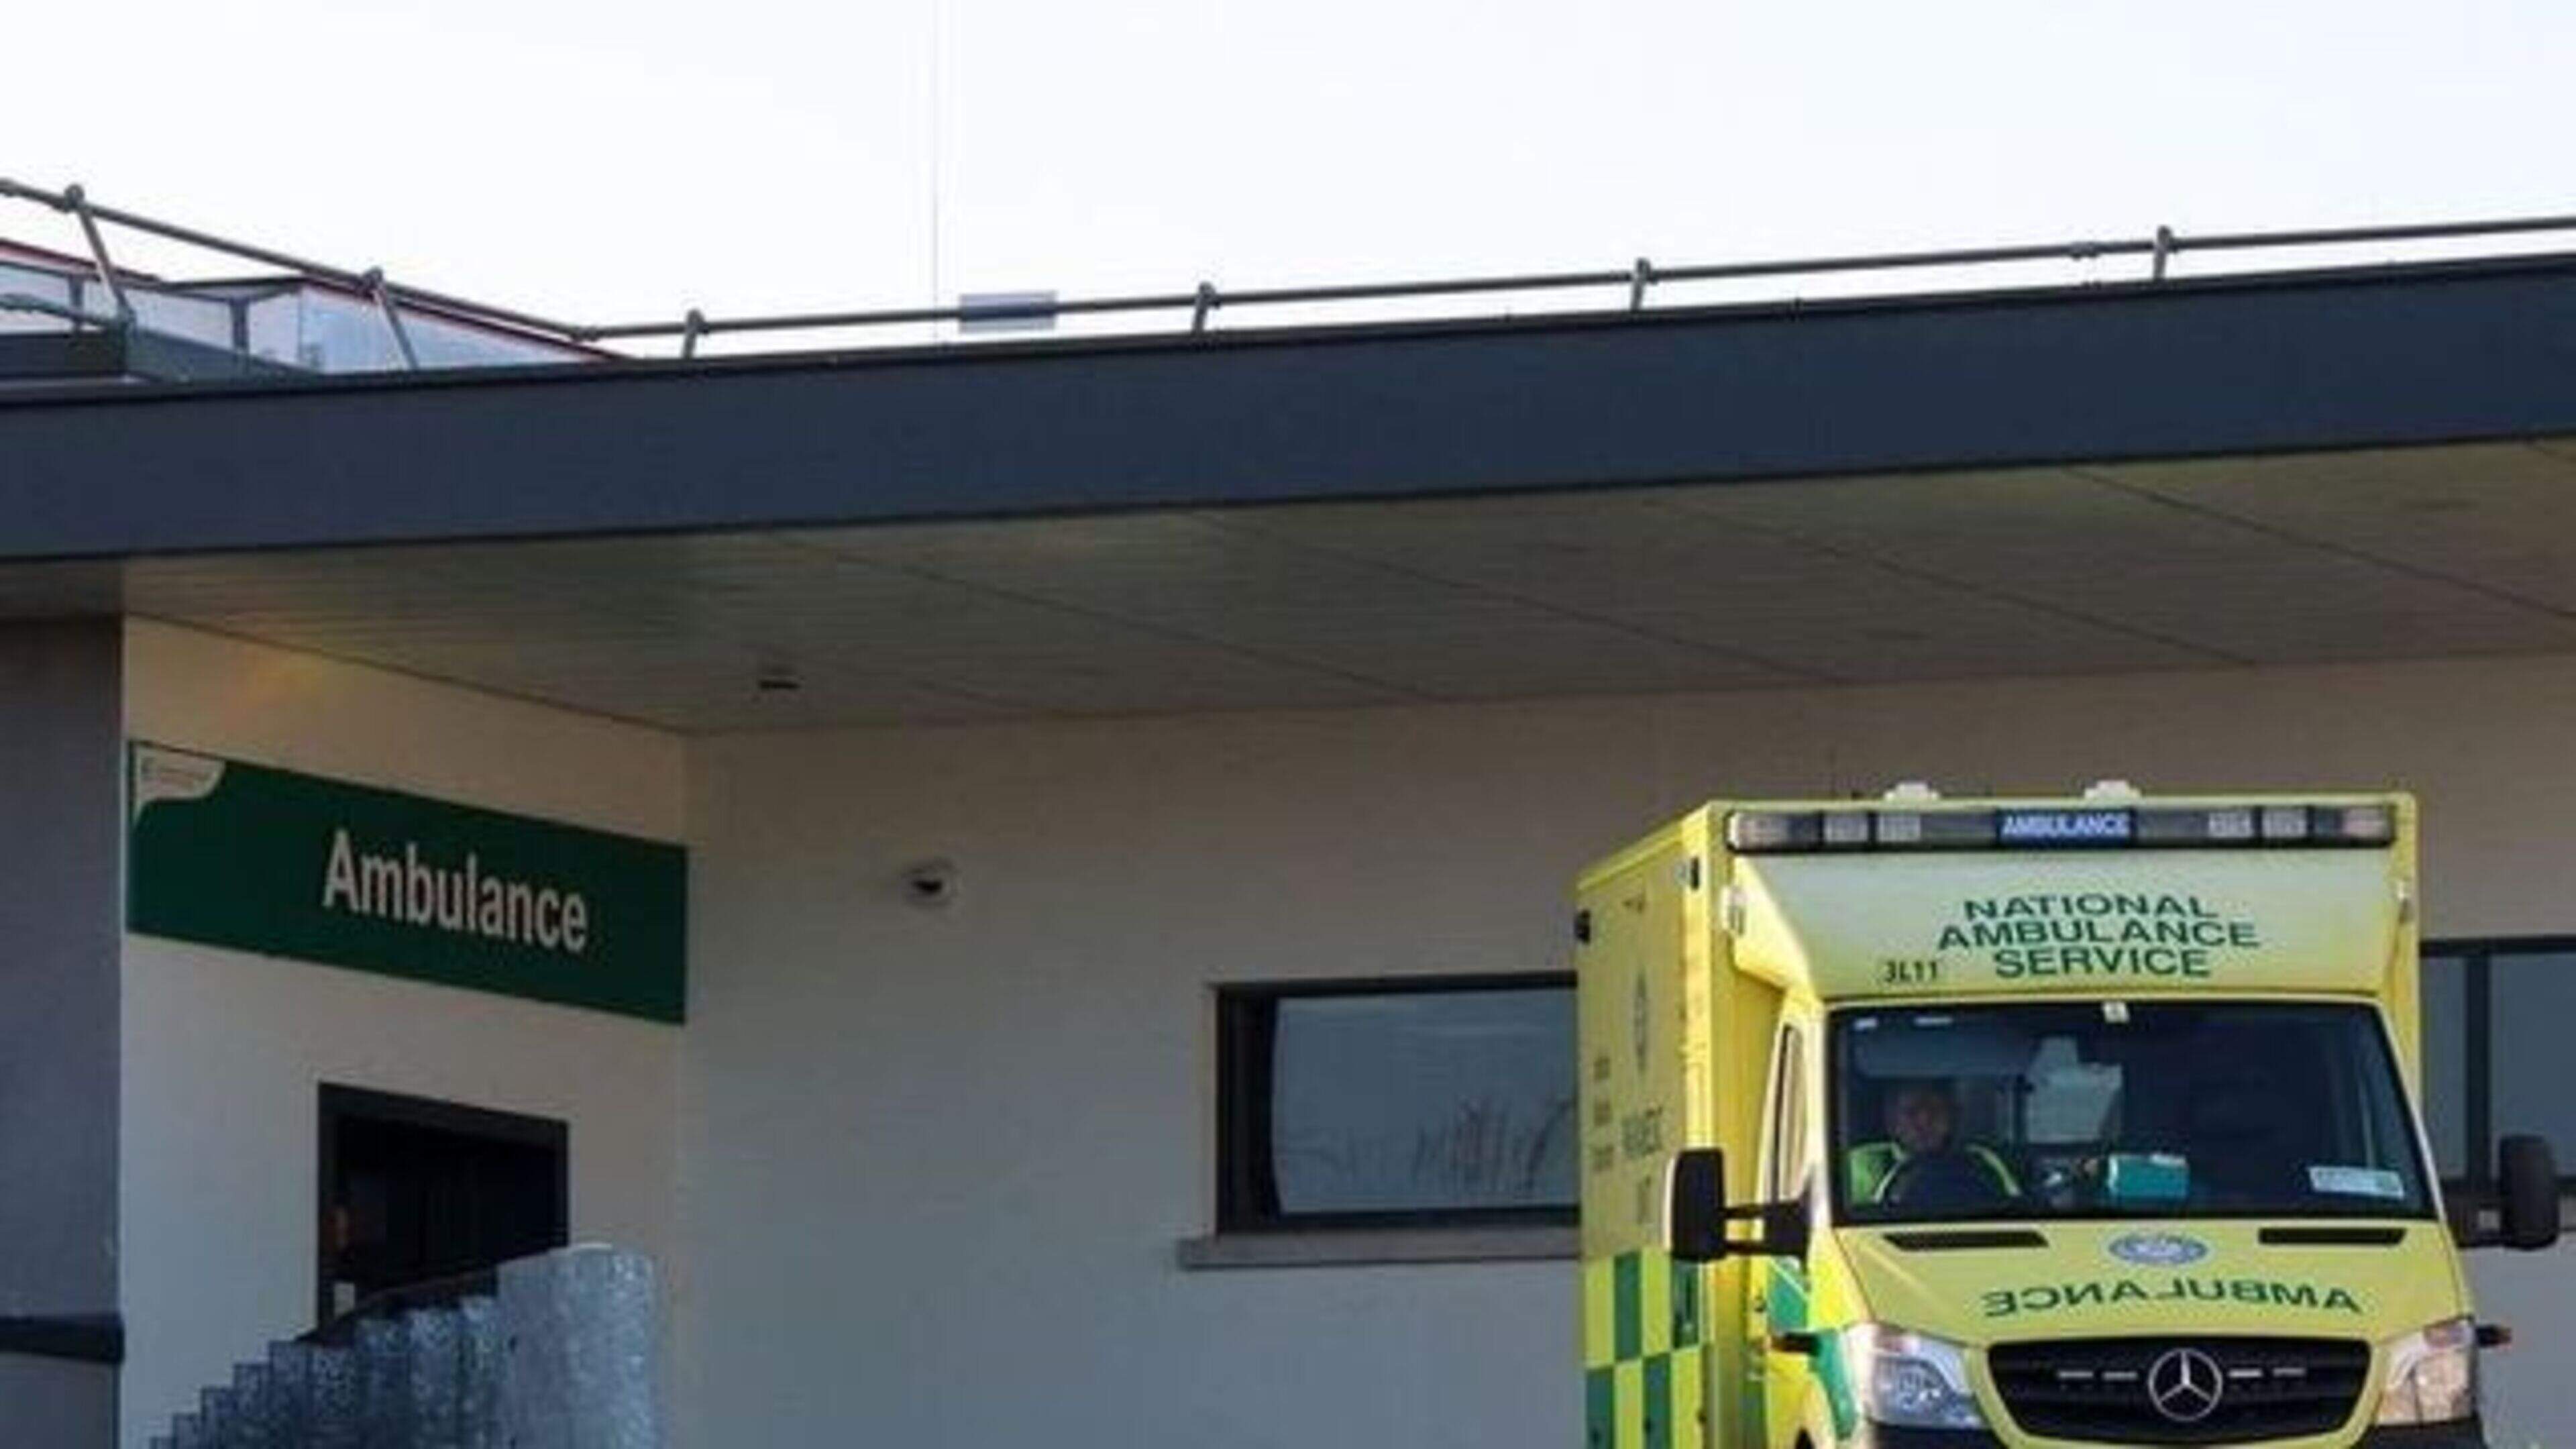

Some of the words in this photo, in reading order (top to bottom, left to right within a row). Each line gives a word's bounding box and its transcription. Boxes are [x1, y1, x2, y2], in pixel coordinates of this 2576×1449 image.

[2001, 814, 2131, 838] AMBULANCE
[322, 828, 588, 953] Ambulance
[1964, 894, 2218, 920] NATIONAL
[1938, 919, 2260, 950] AMBULANCE
[1884, 961, 1939, 983] 3L11
[1994, 947, 2210, 978] SERVICE
